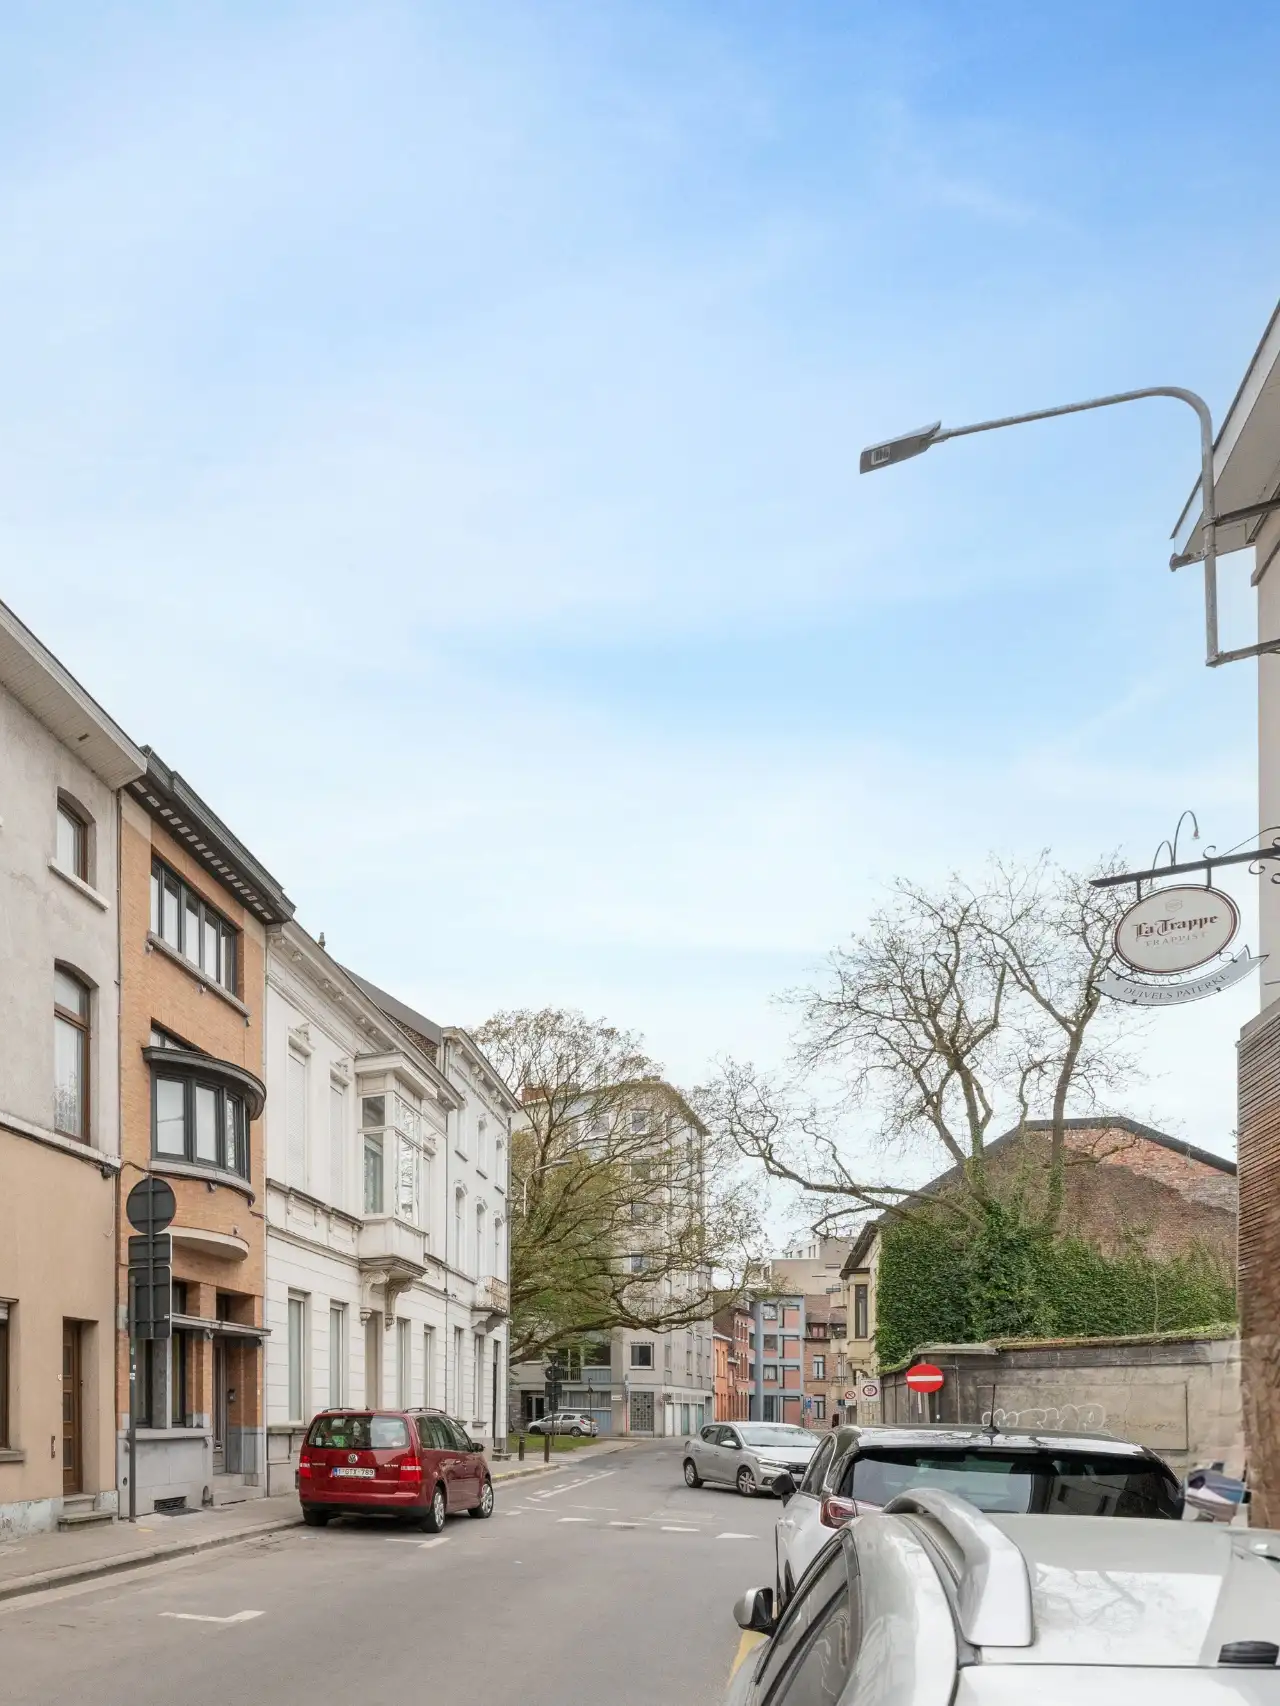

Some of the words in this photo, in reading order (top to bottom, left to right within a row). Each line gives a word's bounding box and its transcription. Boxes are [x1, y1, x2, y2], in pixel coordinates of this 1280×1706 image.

[1132, 922, 1154, 942] La
[1155, 916, 1218, 936] Trappe
[1145, 932, 1208, 946] TRAPPIST
[1123, 987, 1173, 999] DUIVELS
[1176, 975, 1229, 997] PATERKE
